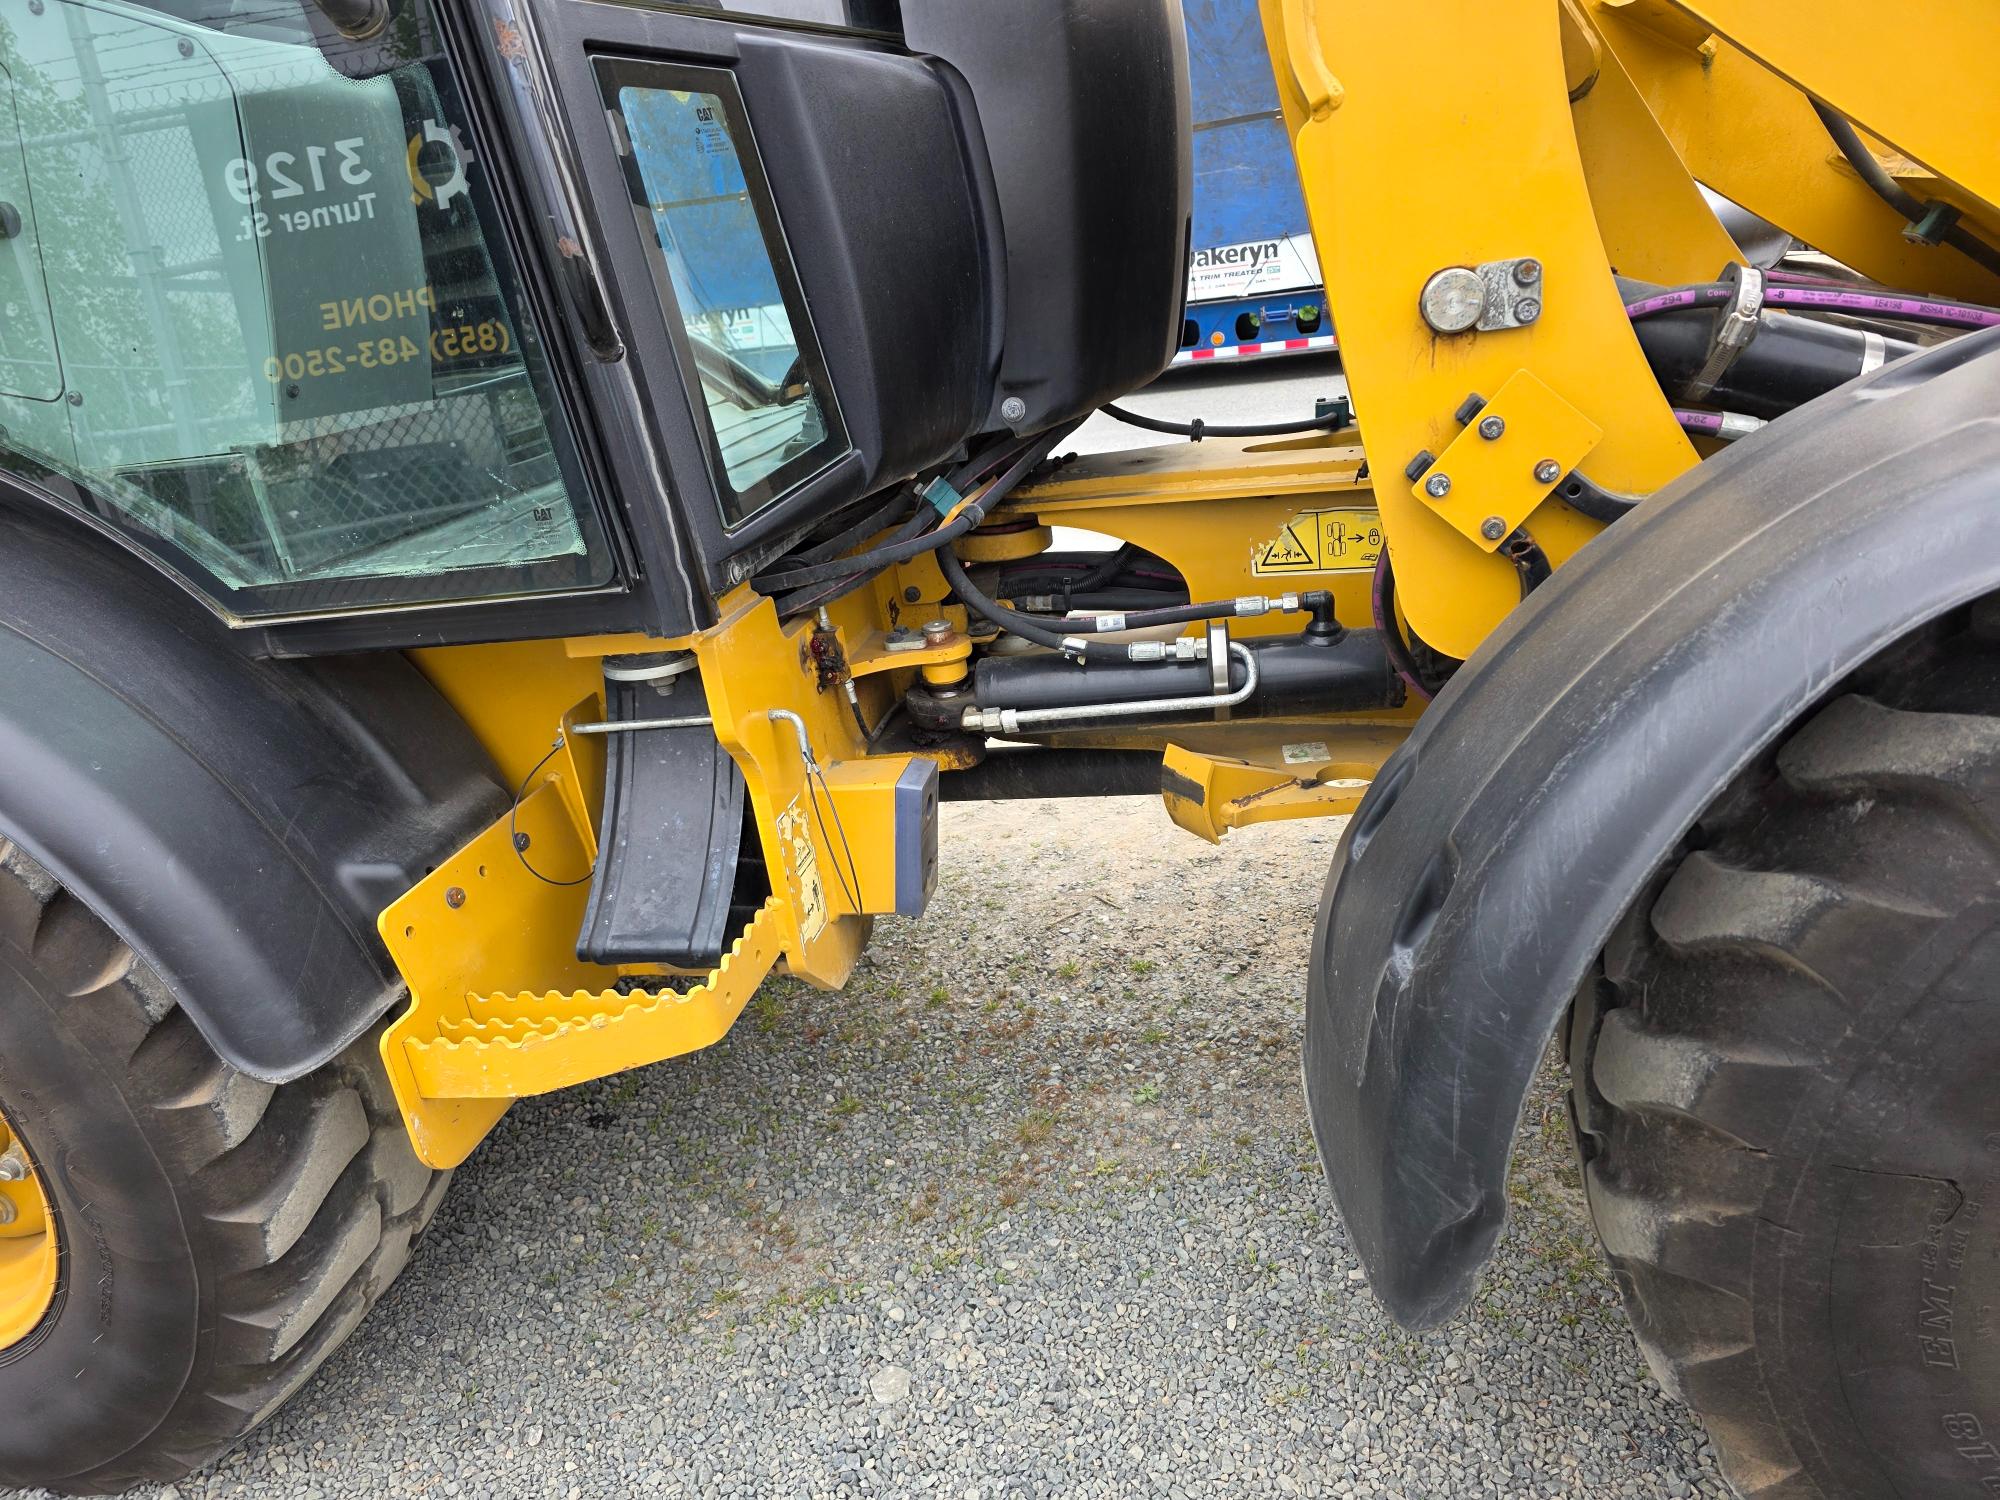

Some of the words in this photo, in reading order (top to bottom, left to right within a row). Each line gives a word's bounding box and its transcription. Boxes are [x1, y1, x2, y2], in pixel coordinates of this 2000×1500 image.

[696, 107, 714, 121] CAT
[1200, 272, 1221, 281] TRIM
[1223, 268, 1263, 278] TREATED
[1661, 294, 1682, 305] 294
[533, 507, 552, 521] CAT
